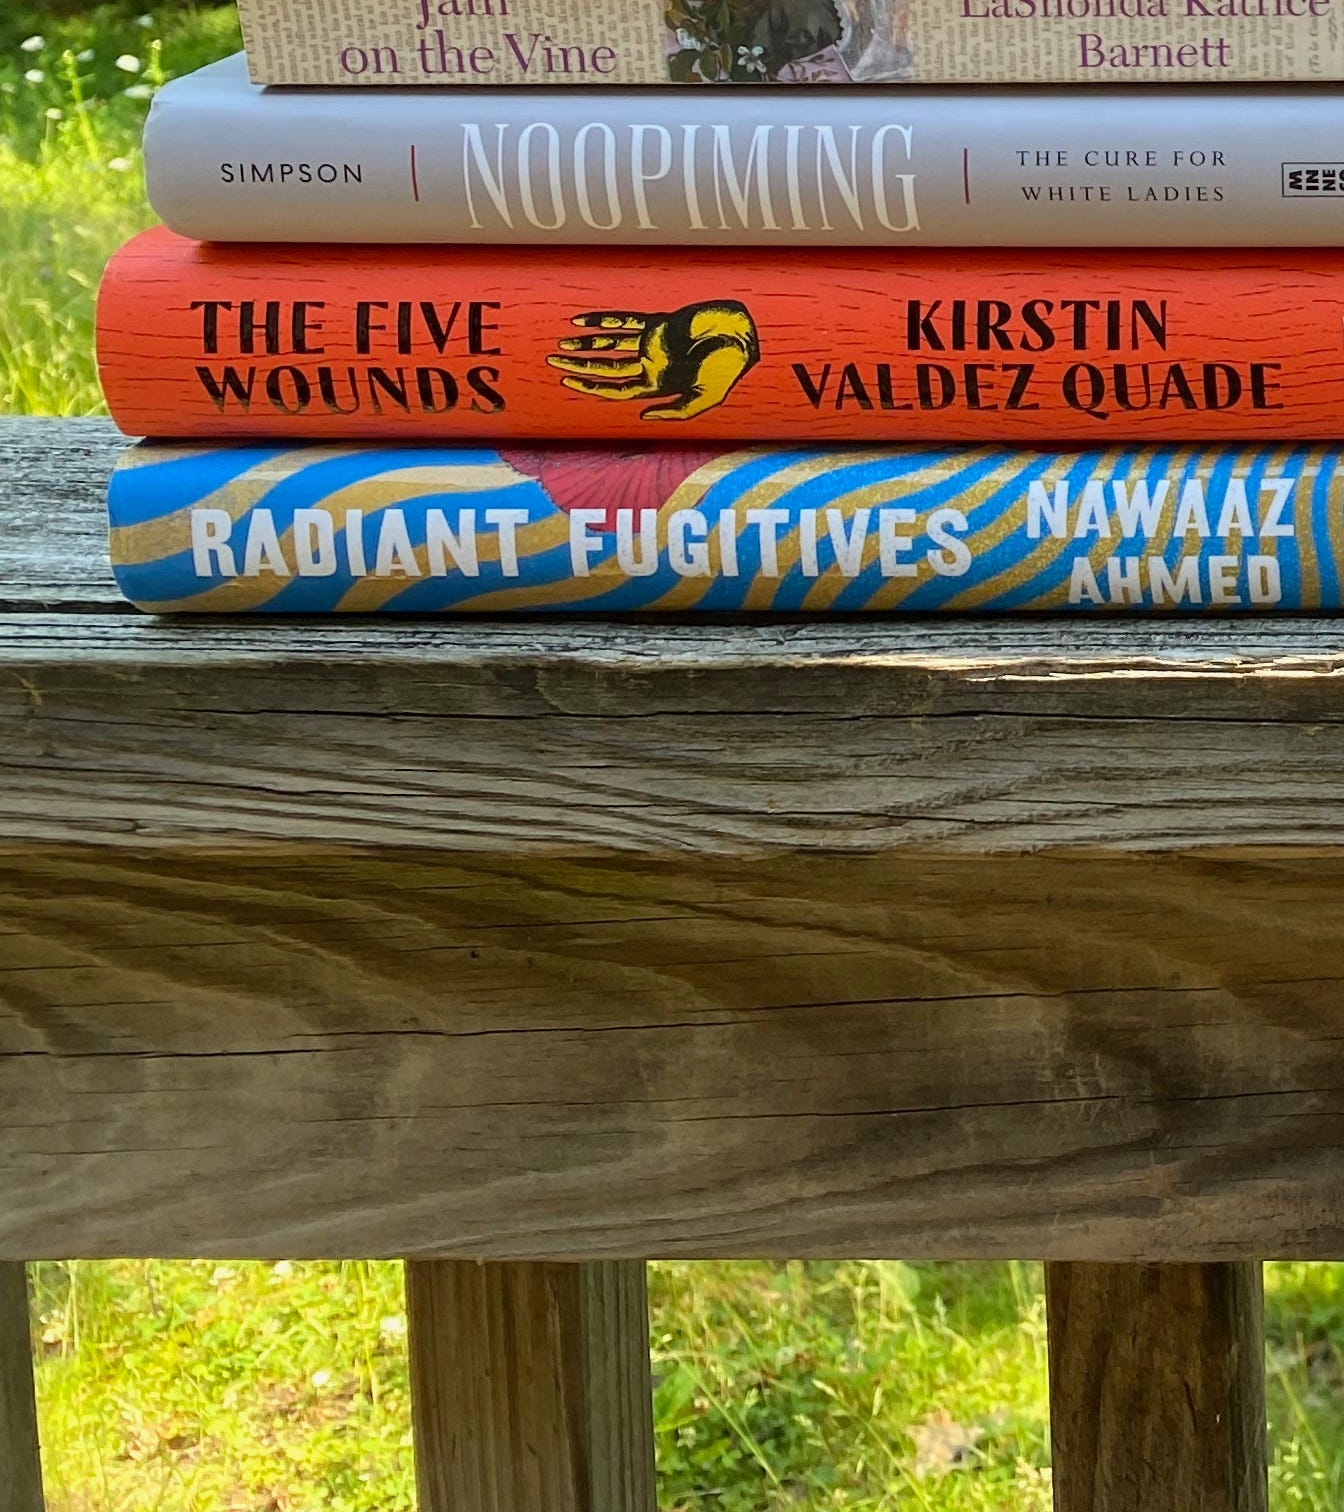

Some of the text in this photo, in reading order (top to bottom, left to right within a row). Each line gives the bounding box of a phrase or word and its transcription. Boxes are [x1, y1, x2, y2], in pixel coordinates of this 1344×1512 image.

[340, 29, 617, 76] on the Vine
[1078, 33, 1231, 69] Barnett
[220, 162, 363, 184] SIMPSON
[461, 121, 921, 233] NOOPIMING
[1016, 150, 1227, 167] THE CURE FOR
[1022, 185, 1225, 202] WHITE LADIES
[190, 299, 502, 356] THE FIVE
[906, 299, 1168, 352] KIRSTIN
[194, 364, 507, 415] WOUNDS
[790, 362, 1285, 420] VALDEZ QUADE
[1025, 478, 1296, 541] NAWAAZ
[190, 507, 973, 578] RADIANT FUGITIVES
[1068, 556, 1283, 605] AHMED
